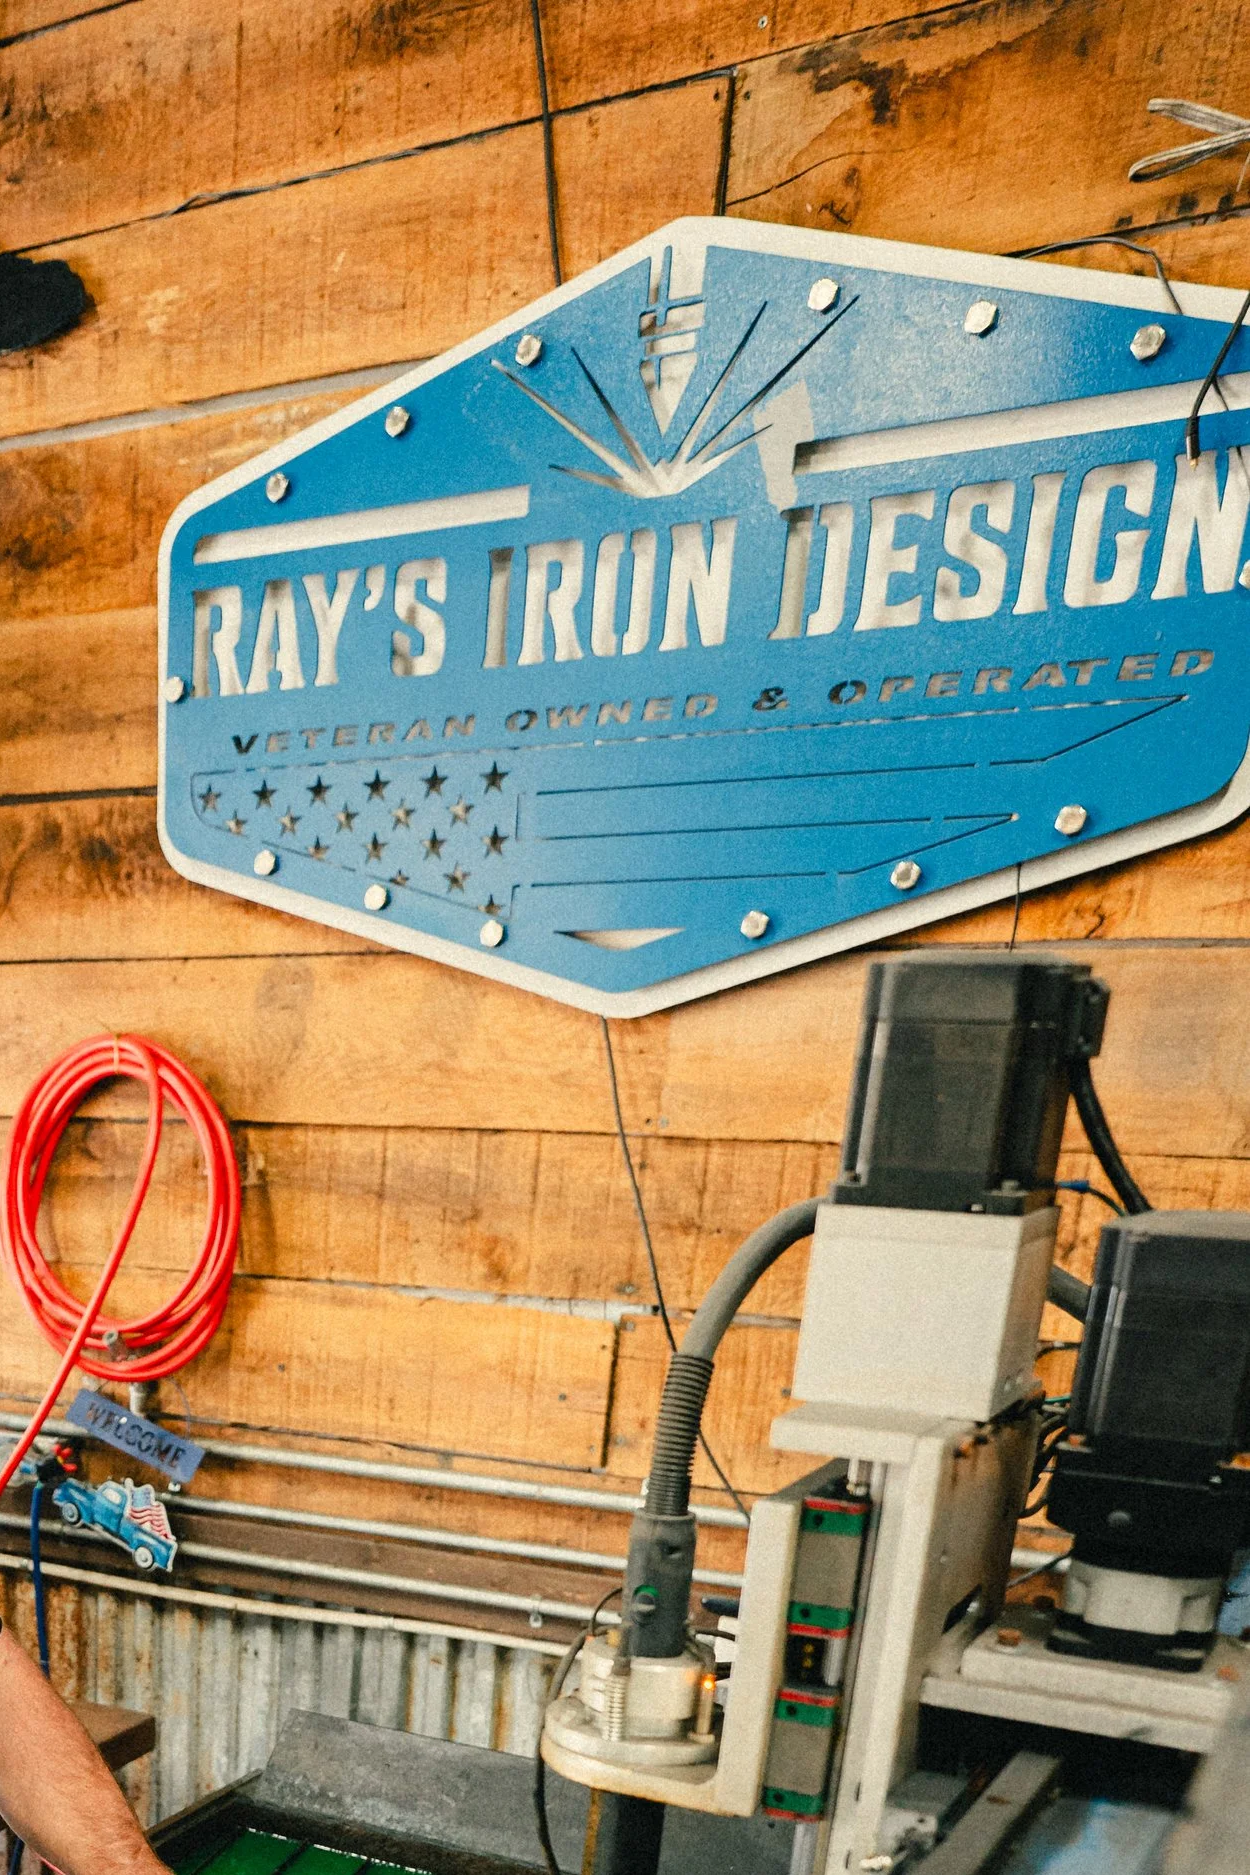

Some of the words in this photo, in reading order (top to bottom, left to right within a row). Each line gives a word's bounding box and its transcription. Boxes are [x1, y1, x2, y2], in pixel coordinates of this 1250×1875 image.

[189, 557, 448, 698] RAY'S
[482, 518, 739, 668] IRON
[767, 444, 1250, 641] DESIGN
[232, 714, 476, 756] VETERAN
[505, 693, 720, 732] OWNED
[752, 686, 789, 712] &
[828, 648, 1216, 705] OPERATED
[87, 1402, 187, 1468] WELCOME
